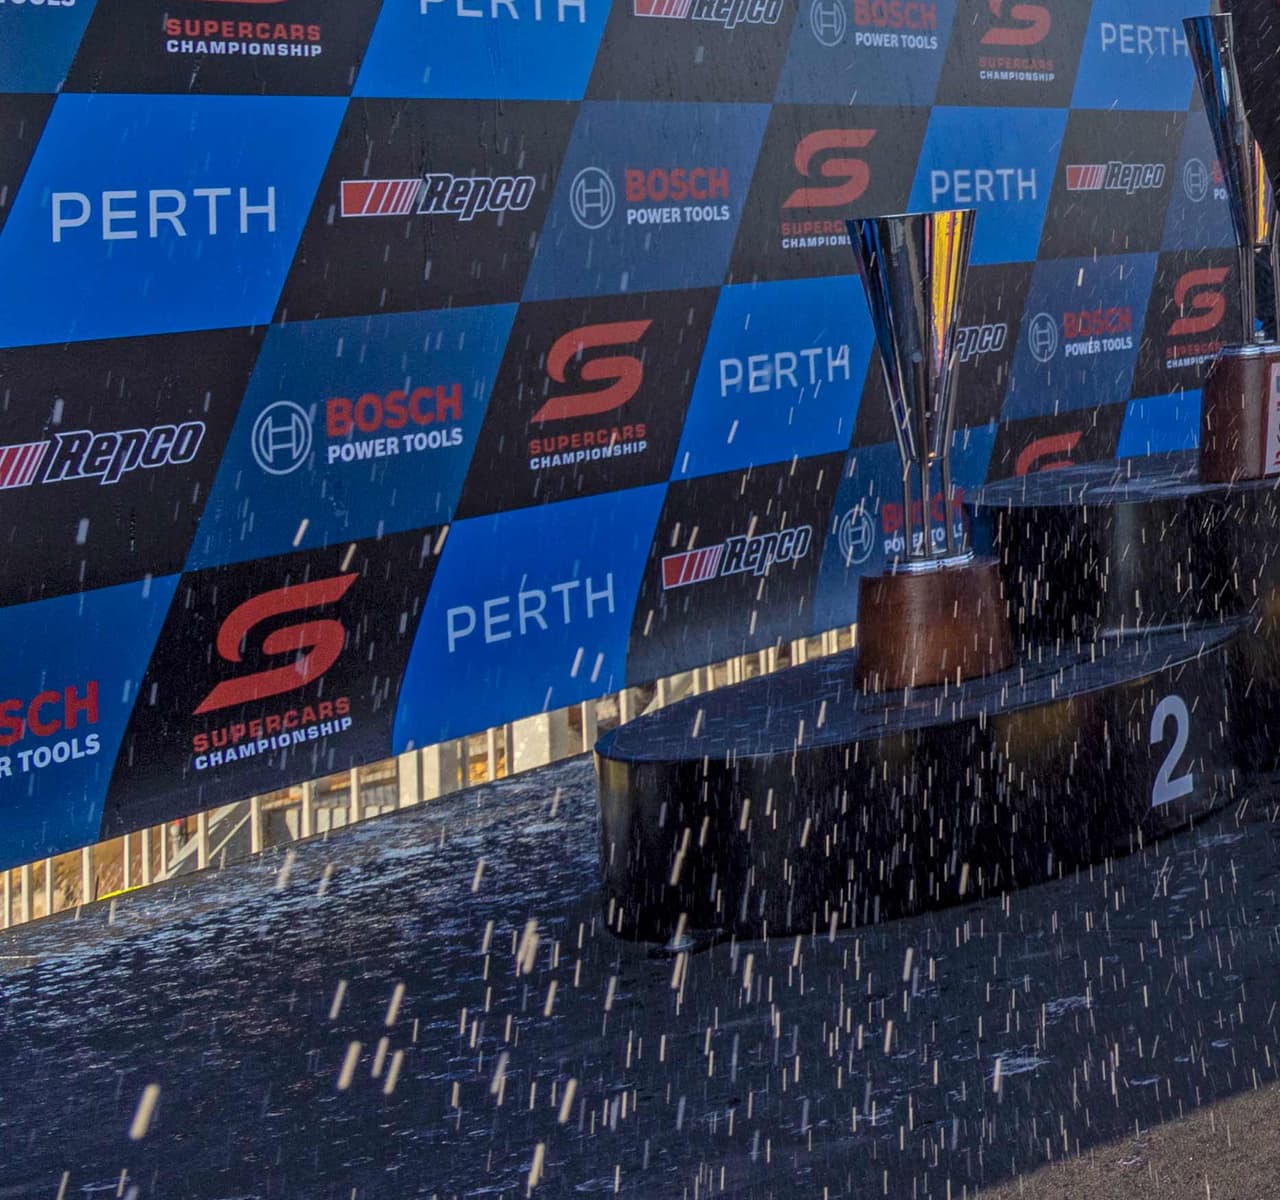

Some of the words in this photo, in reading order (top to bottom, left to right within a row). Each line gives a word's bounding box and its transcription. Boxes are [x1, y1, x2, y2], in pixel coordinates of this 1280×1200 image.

[166, 18, 321, 41] SUPERCARS
[855, 32, 898, 49] POWER
[900, 34, 938, 50] TOOLS
[1100, 22, 1190, 58] PERTH
[166, 39, 322, 57] CHAMPIONSHIP
[979, 69, 1056, 82] CHAMPIONSHIP
[625, 168, 729, 202] BOSCH
[931, 169, 1037, 204] PERTH
[1104, 161, 1165, 195] Repco
[52, 186, 276, 243] PERTH
[417, 172, 536, 221] Repco
[627, 206, 680, 225] POWER
[683, 204, 730, 222] TOOLS
[781, 220, 846, 237] SUPERC
[782, 234, 852, 249] CHAMPIONS
[1063, 306, 1133, 340] BOSCH
[955, 322, 1008, 363] epco
[1064, 340, 1099, 357] POWER
[1100, 336, 1133, 354] TOOLS
[720, 344, 850, 397] PERTH
[326, 383, 463, 439] BOSCH
[43, 421, 206, 485] Repco
[327, 438, 399, 465] POWER
[402, 427, 463, 455] TOOLS
[528, 423, 647, 456] SUPERCARS
[530, 440, 647, 471] CHAMPIONSHIP
[721, 524, 813, 576] Repco
[447, 573, 616, 654] PERTH
[0, 681, 98, 746] SCH
[192, 697, 351, 753] SUPERCARS
[17, 733, 100, 772] TOOLS
[194, 716, 353, 772] CHAMPIONSHIP
[1150, 695, 1194, 807] 2
